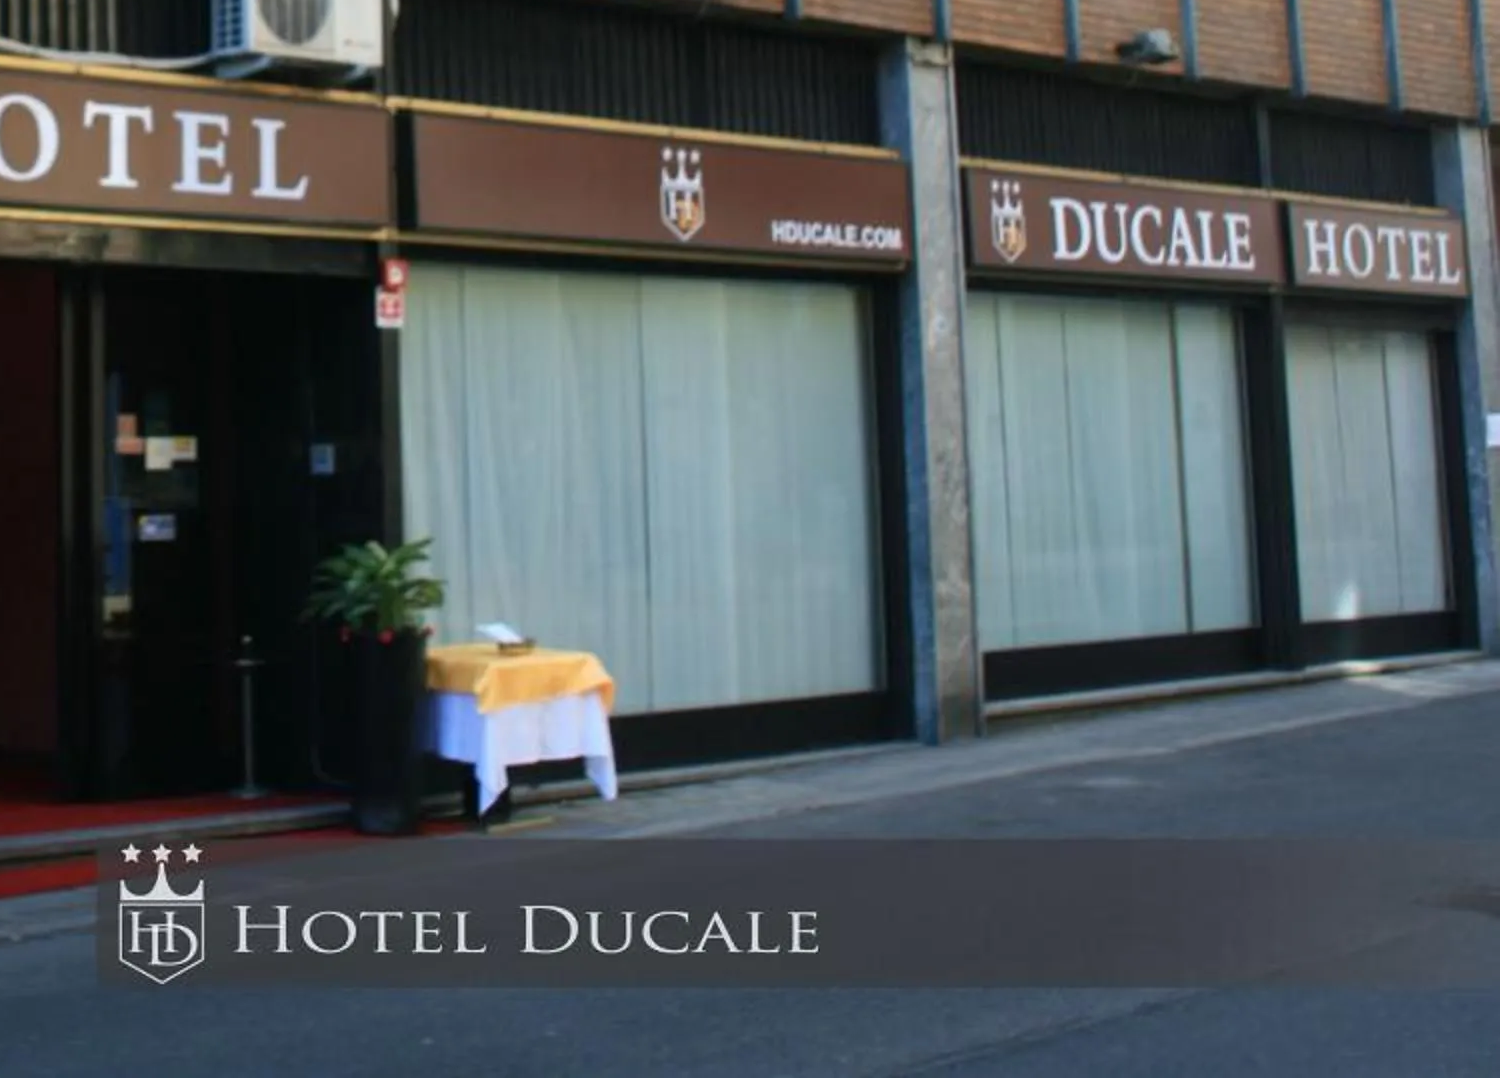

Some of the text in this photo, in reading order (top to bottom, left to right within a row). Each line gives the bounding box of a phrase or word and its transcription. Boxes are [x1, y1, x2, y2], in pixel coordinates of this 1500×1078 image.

[771, 220, 903, 250] HDUCALE.COM
[1049, 196, 1256, 272] DUCALE
[1303, 219, 1461, 286] HOTEL
